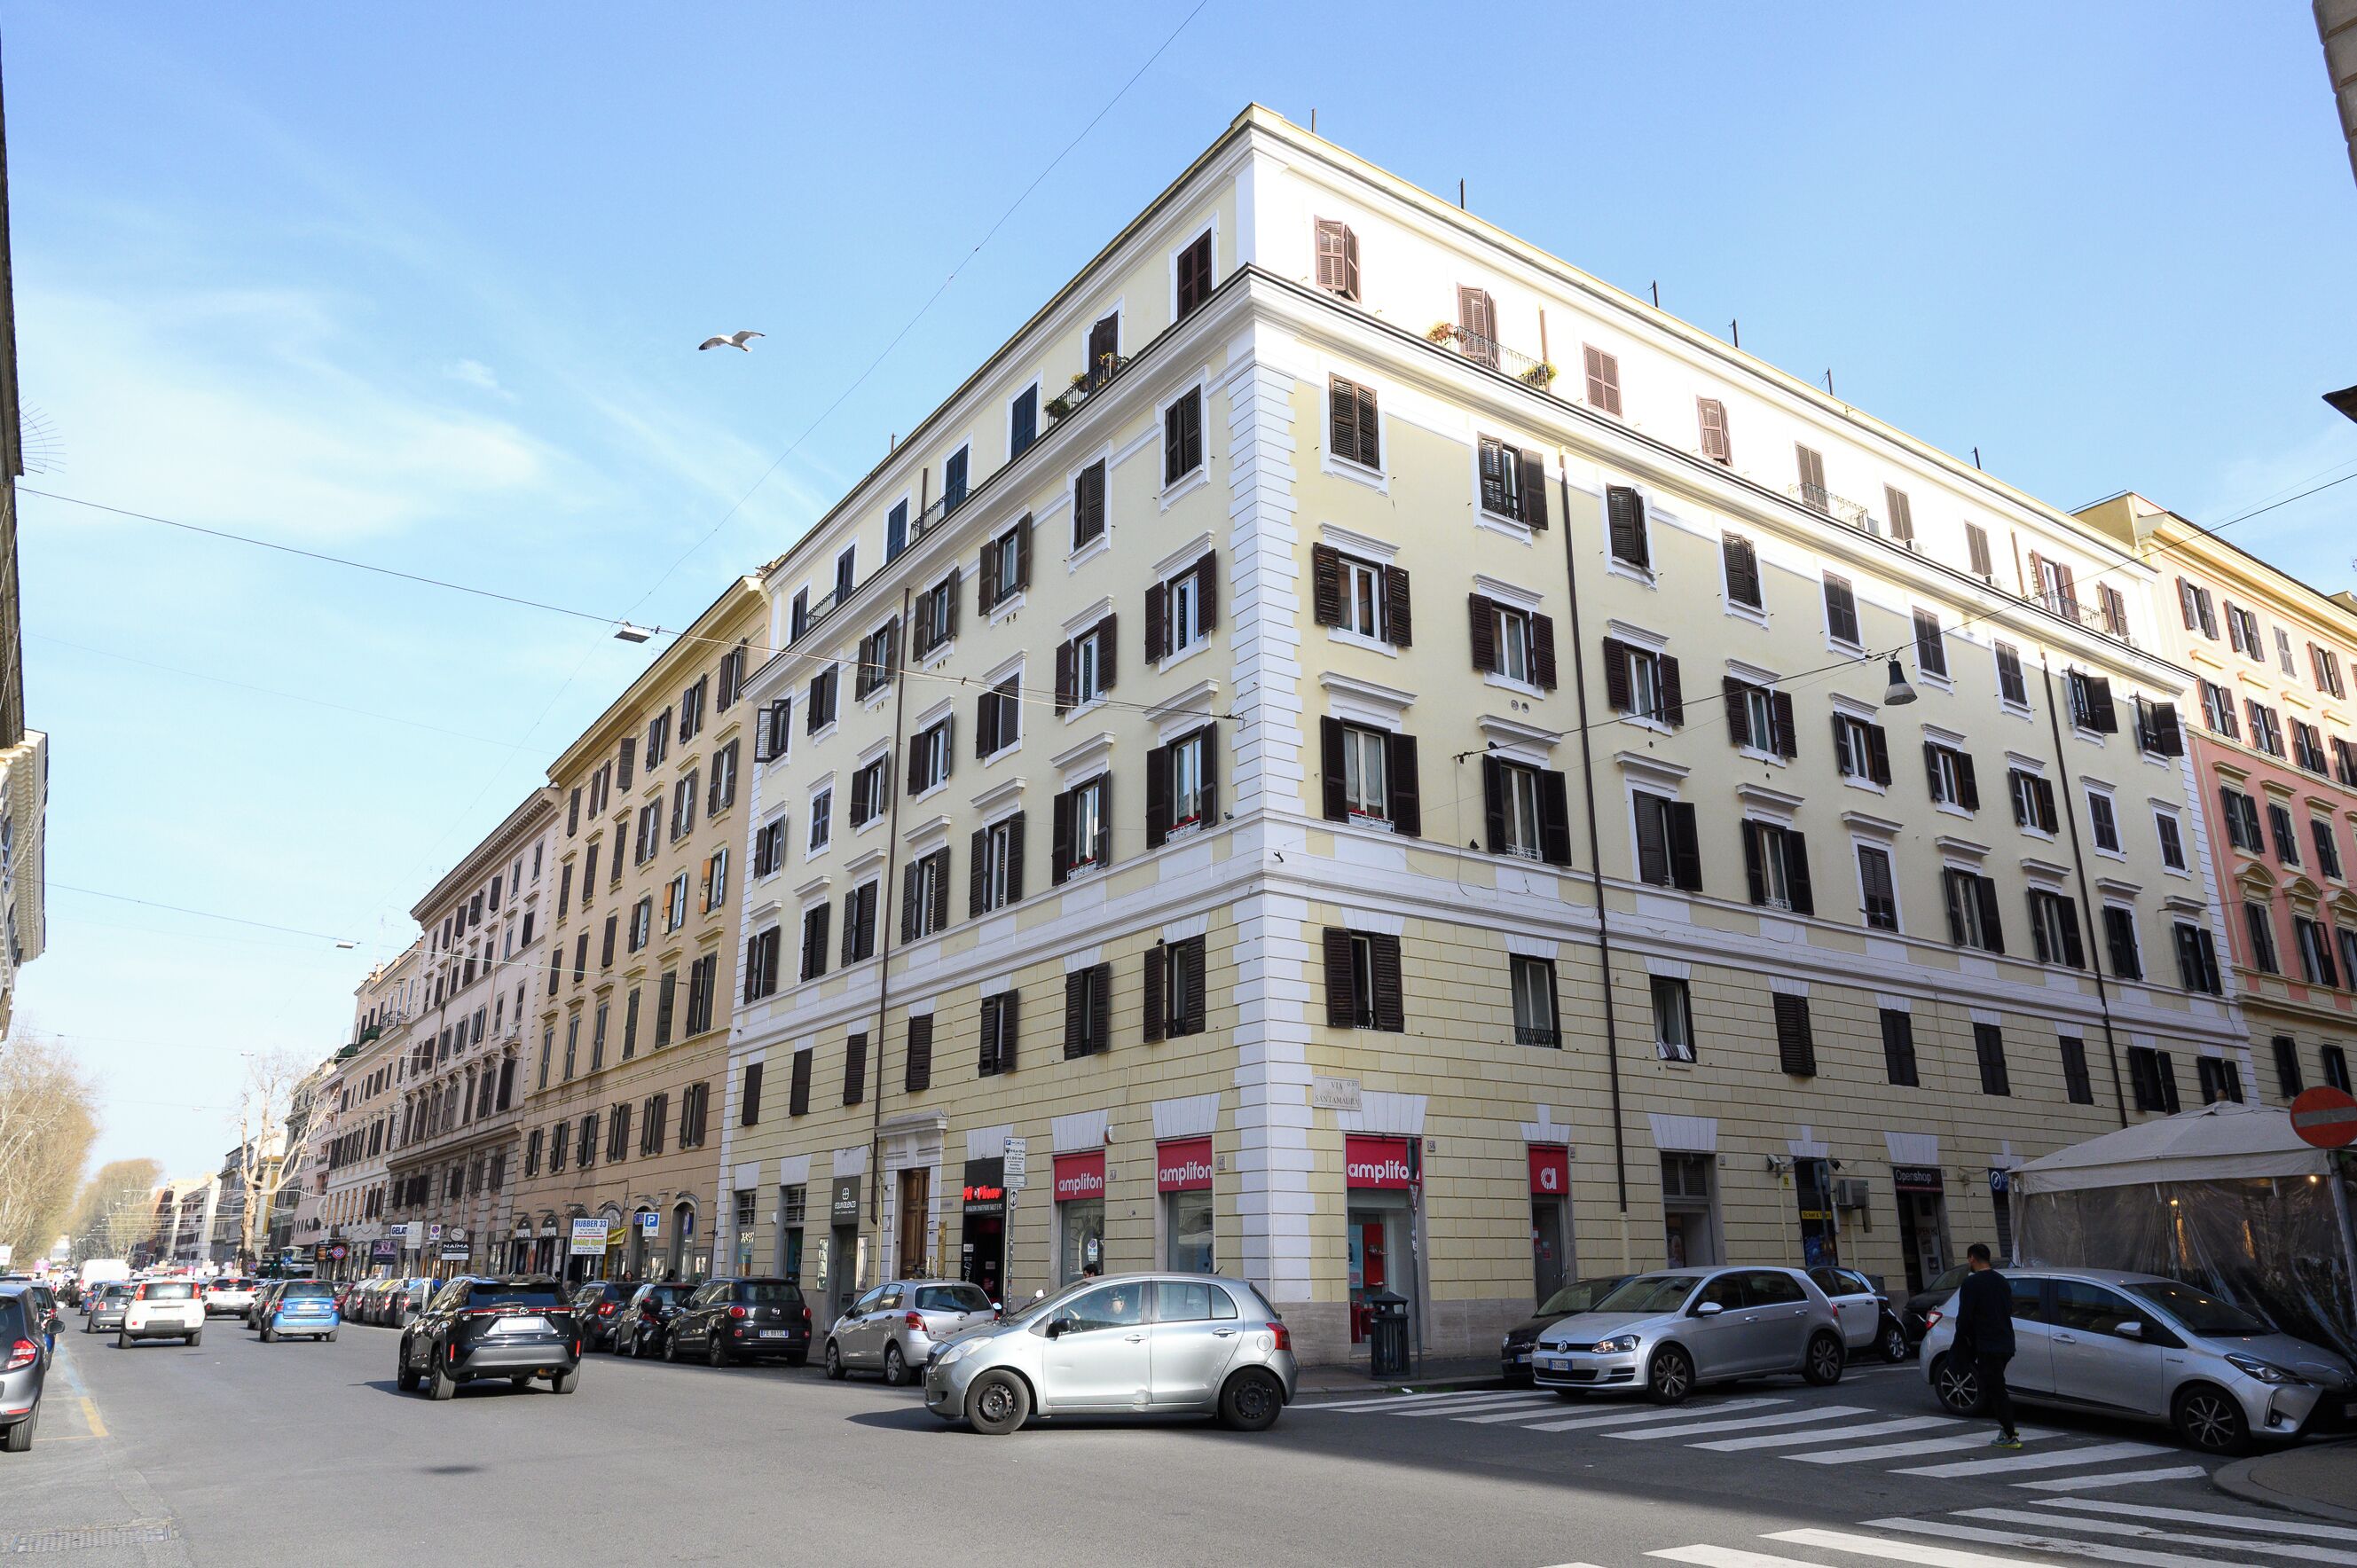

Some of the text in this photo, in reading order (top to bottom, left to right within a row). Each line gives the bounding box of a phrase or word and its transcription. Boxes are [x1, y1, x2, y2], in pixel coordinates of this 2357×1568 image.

[1331, 1081, 1343, 1090] VIA
[1316, 1095, 1359, 1105] SANTAMAURA
[1159, 1160, 1213, 1186] amplifon
[1347, 1160, 1419, 1184] amplifo
[1059, 1172, 1102, 1195] amplifon
[648, 1217, 655, 1225] P
